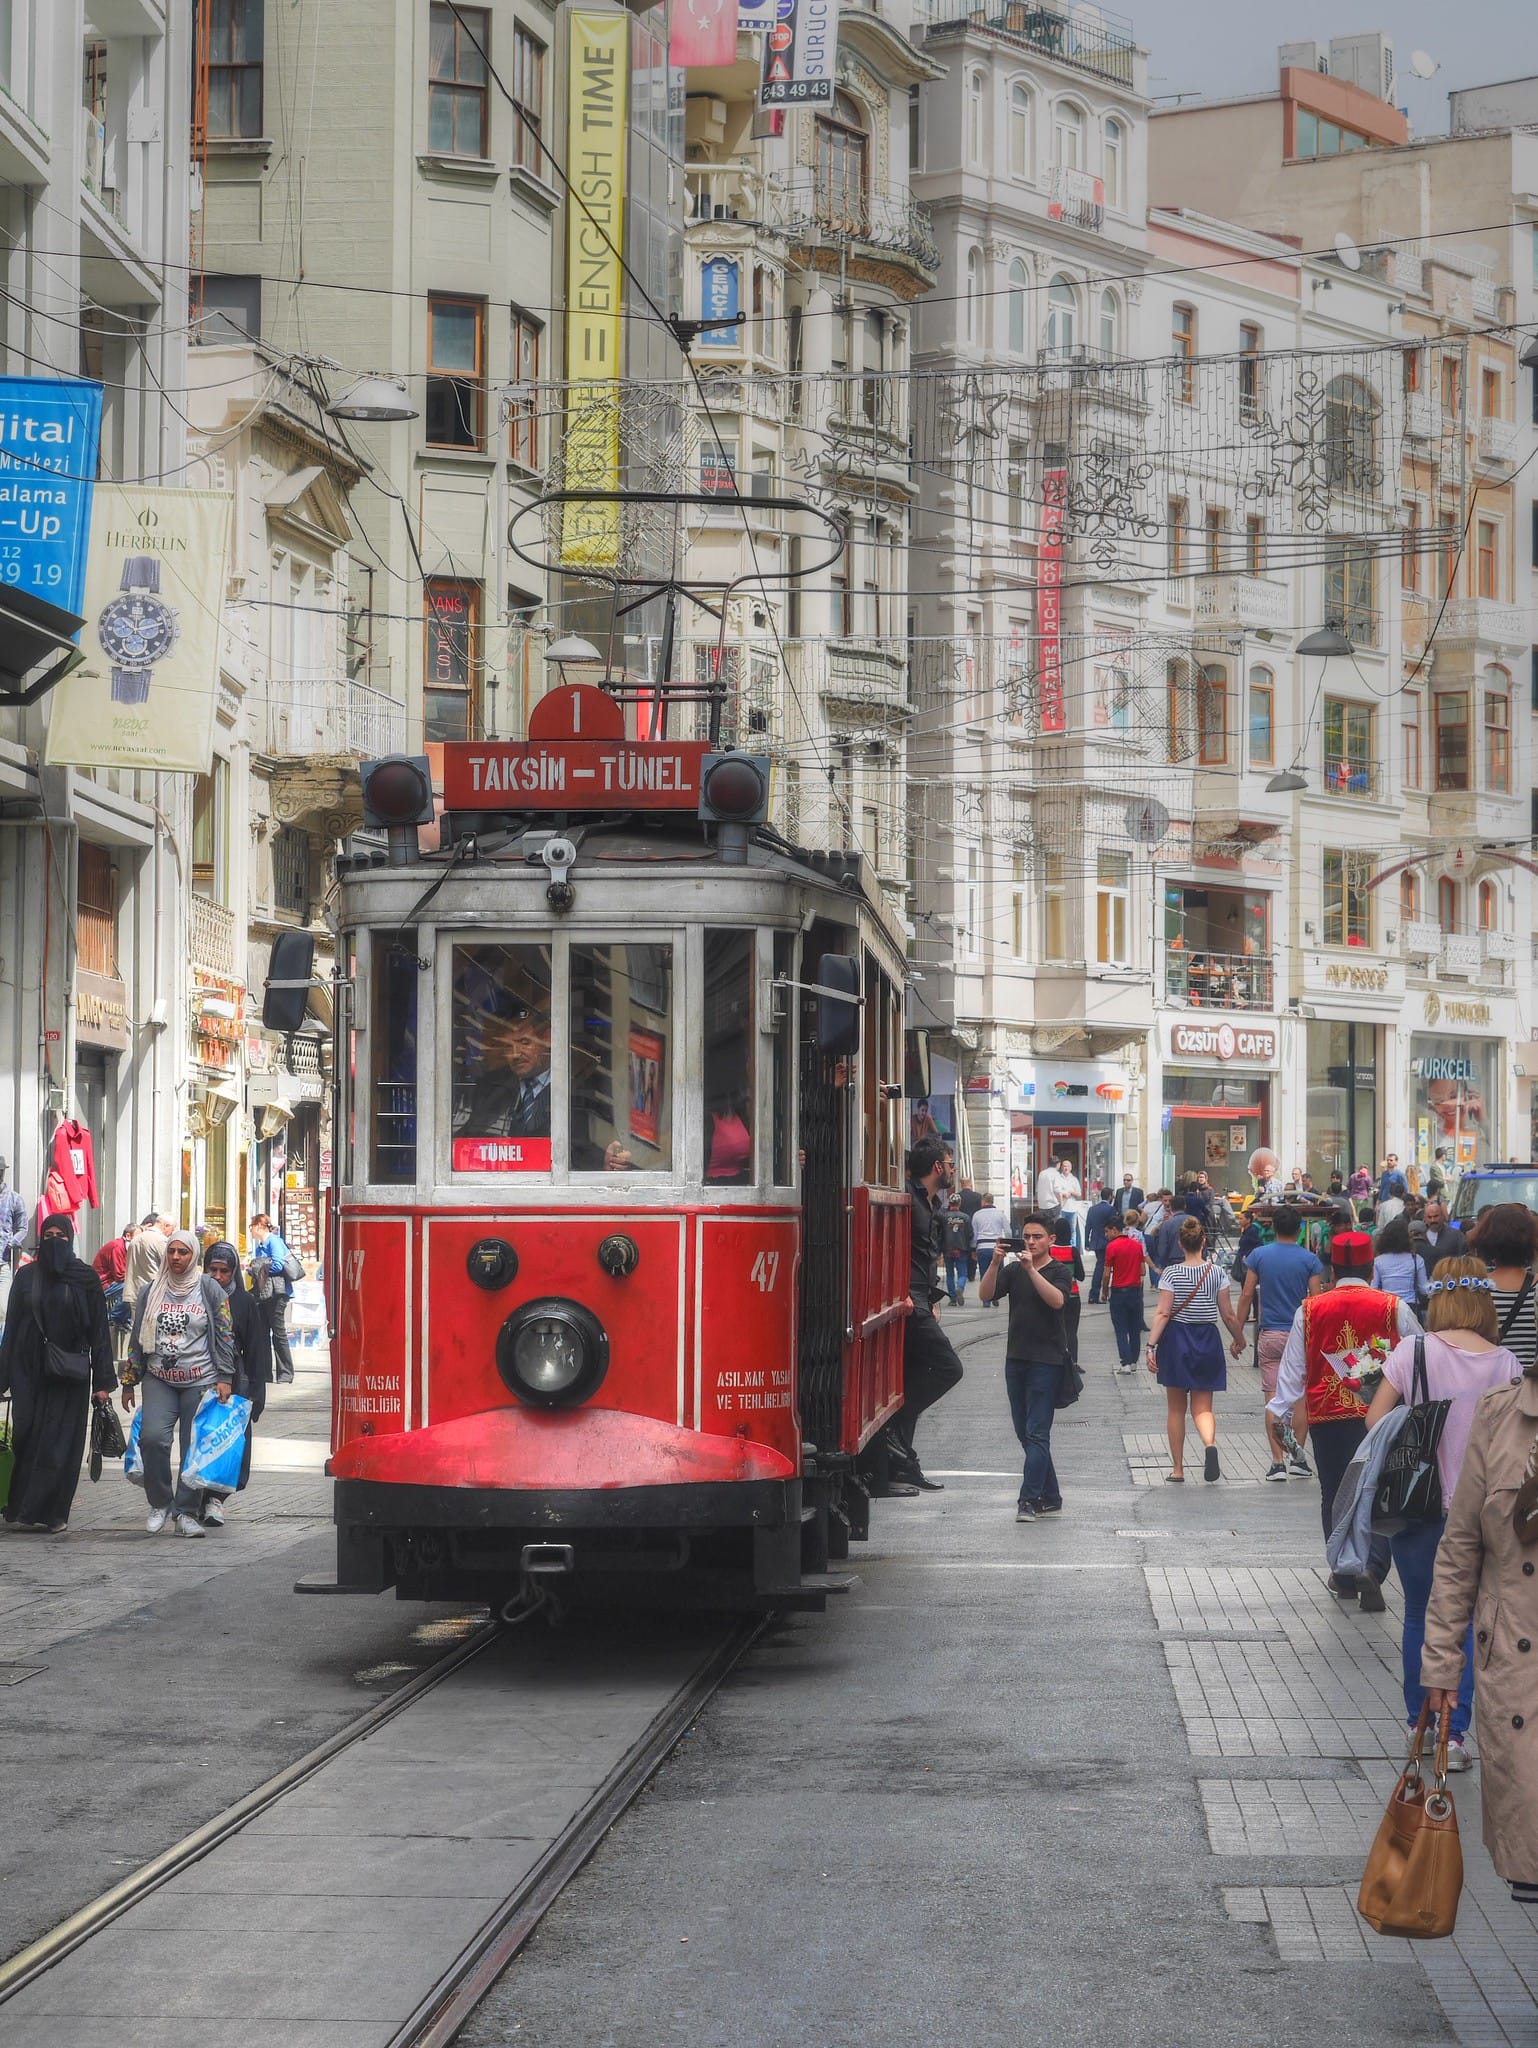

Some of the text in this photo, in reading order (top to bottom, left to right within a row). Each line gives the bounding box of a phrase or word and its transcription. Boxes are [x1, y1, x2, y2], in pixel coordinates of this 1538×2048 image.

[771, 32, 789, 42] STOP
[805, 0, 829, 75] SÜRÜC
[583, 47, 615, 132] TIME
[789, 85, 807, 97] 49
[810, 83, 828, 96] 43
[579, 152, 612, 311] ENGLISH
[711, 263, 729, 338] GENÇTR
[1, 451, 70, 474] Merkezi
[2, 547, 21, 559] 12
[32, 564, 62, 586] 19
[1043, 562, 1057, 631] KÜLTÜR
[570, 691, 581, 733] 1
[469, 750, 566, 791] TAKSİM
[600, 750, 692, 791] TÜNEL
[1177, 1026, 1272, 1055] ÖZSÜT CAFE
[1416, 1057, 1476, 1080] TURKCELL
[479, 1142, 524, 1162] TÜNEL
[751, 1251, 779, 1292] 47
[186, 1303, 204, 1315] CUP
[365, 1375, 400, 1390] YASAK
[717, 1371, 765, 1387] ASILMAK
[716, 1394, 733, 1410] VE
